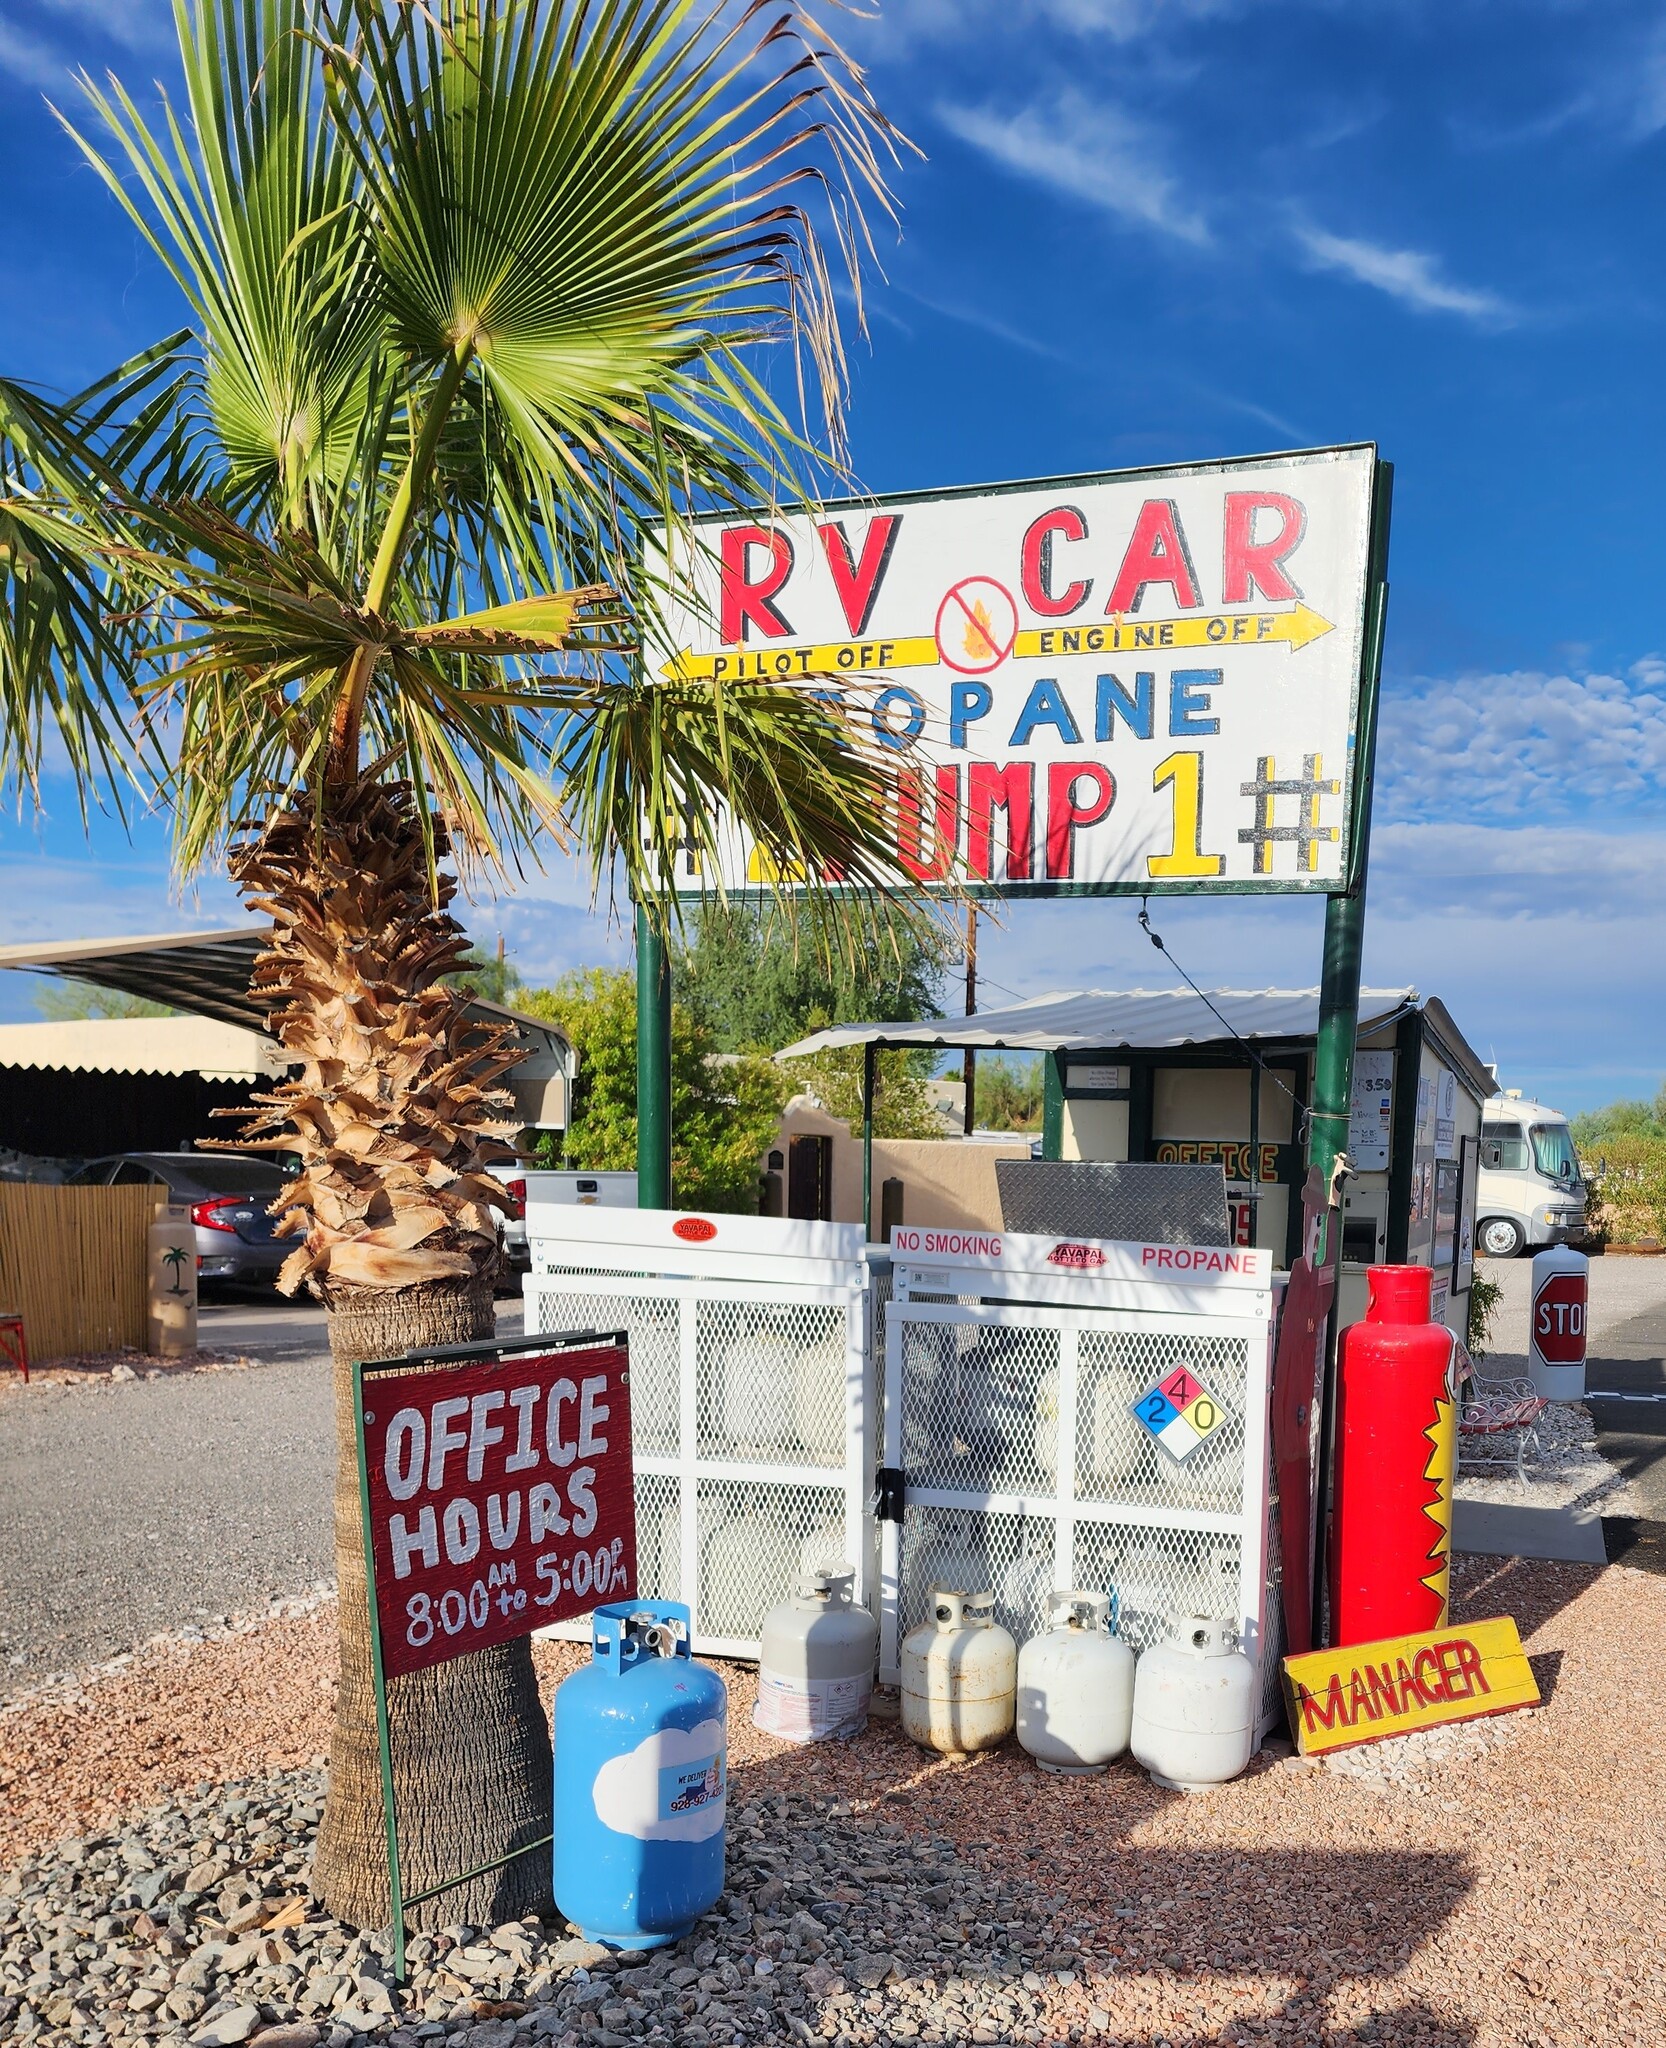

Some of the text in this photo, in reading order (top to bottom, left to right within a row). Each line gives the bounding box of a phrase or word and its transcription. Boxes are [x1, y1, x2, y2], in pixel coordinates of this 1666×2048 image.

[720, 490, 1309, 646] RV CAR
[1040, 616, 1275, 653] ENGINE OFF
[714, 643, 895, 679] PILOT OFF
[809, 668, 1224, 751] OPANE
[822, 761, 1117, 882] UMP
[1156, 1142, 1279, 1183] OFFICE
[897, 1231, 1002, 1256] NO SMOKING
[1055, 1247, 1102, 1259] YAVAPAI
[1142, 1247, 1257, 1274] PROPANE
[1168, 1374, 1189, 1405] 4
[1148, 1396, 1166, 1423] 2
[1194, 1401, 1215, 1430] 0
[384, 1374, 611, 1501] OFFICE
[389, 1466, 598, 1580] HOURS
[496, 1588, 528, 1616] to
[1298, 1638, 1492, 1734] MANAGER
[678, 1775, 687, 1784] WE
